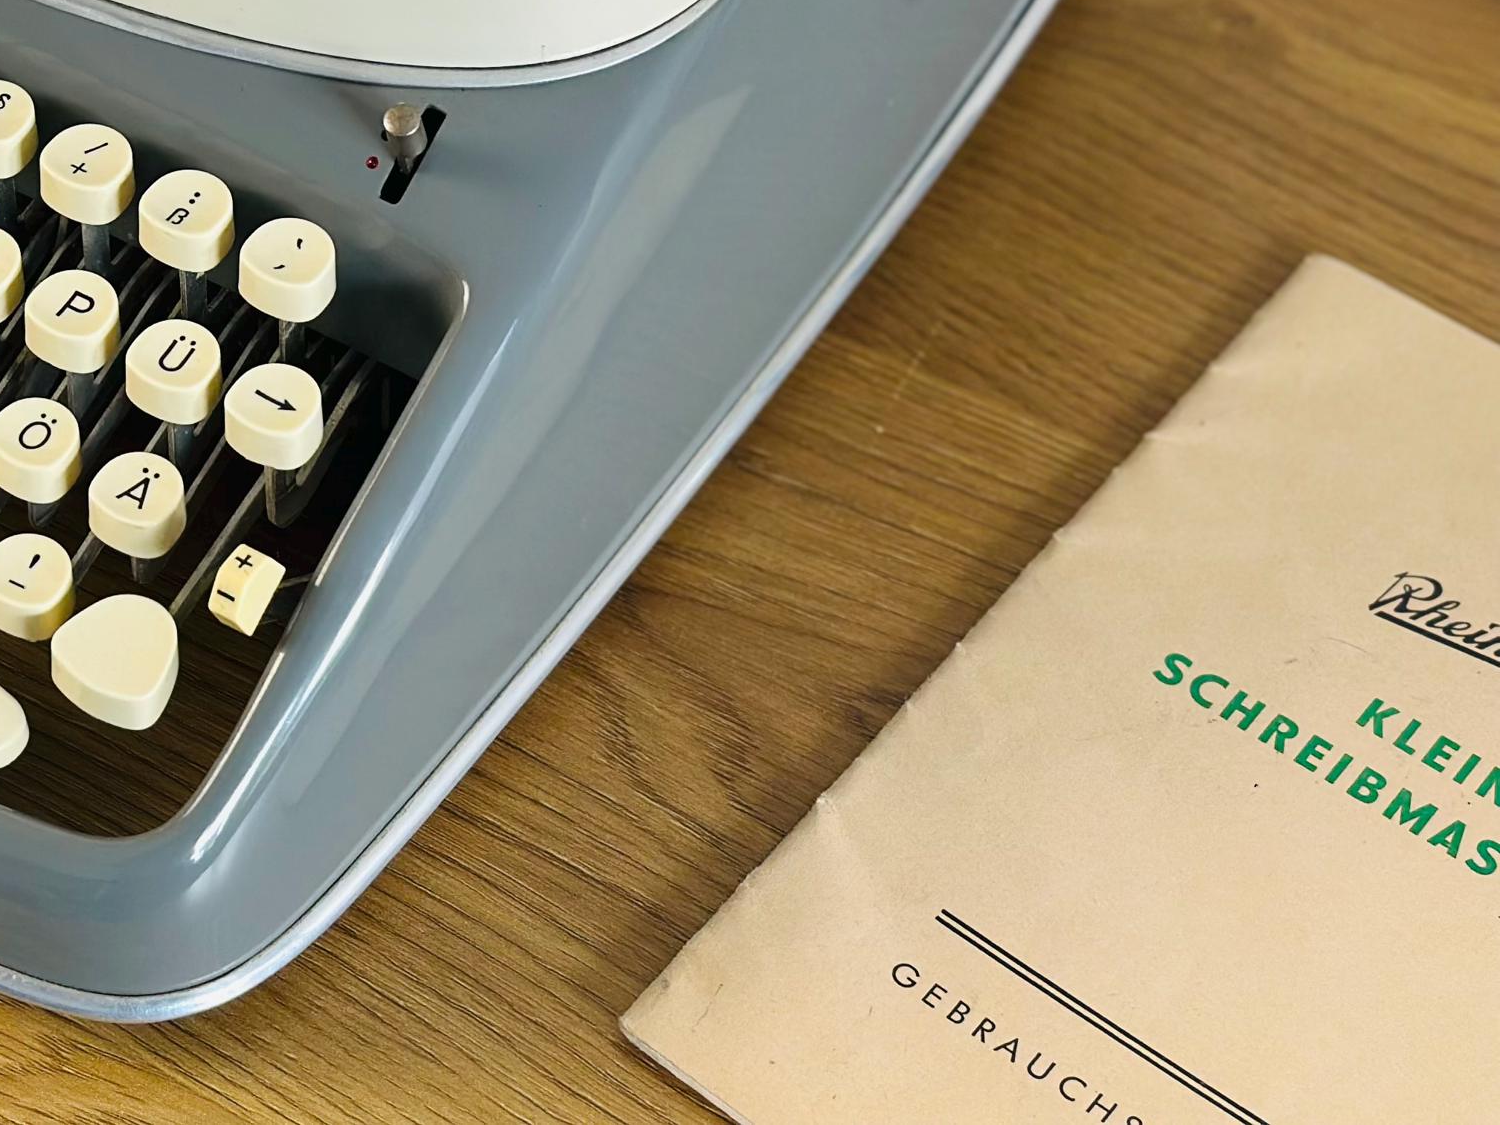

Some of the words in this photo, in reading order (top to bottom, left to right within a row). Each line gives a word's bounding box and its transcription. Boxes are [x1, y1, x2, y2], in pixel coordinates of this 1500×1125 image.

[56, 291, 95, 316] P
[159, 336, 196, 371] Ü
[19, 414, 57, 449] Ö
[116, 468, 160, 509] Ä
[1152, 652, 1500, 876] SCHREIBMAS
